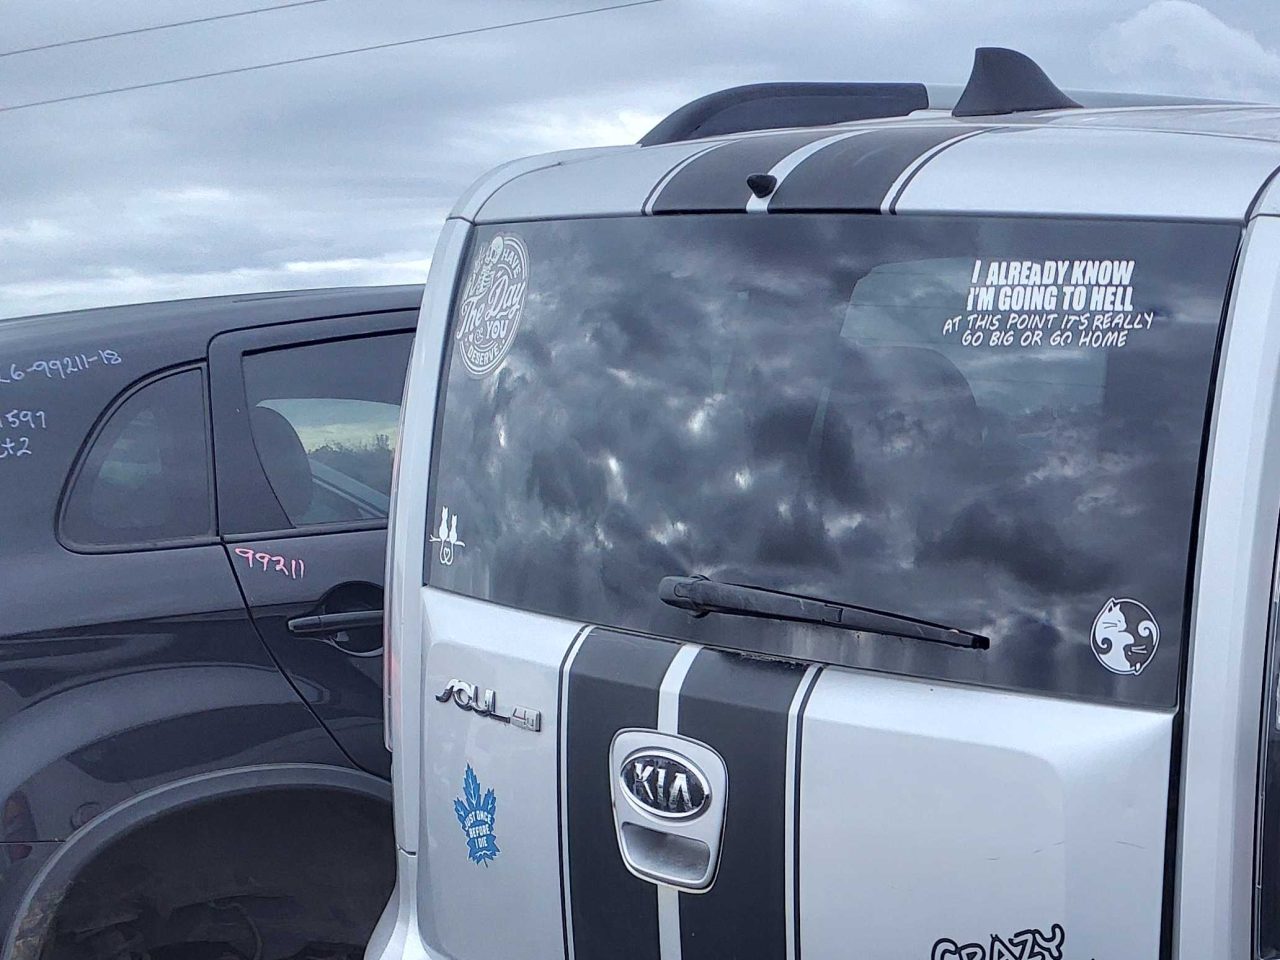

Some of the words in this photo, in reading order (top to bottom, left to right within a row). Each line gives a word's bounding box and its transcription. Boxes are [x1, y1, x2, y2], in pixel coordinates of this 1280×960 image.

[501, 249, 522, 279] HAVE
[971, 260, 981, 284] I
[986, 260, 1069, 285] ALREADY
[1071, 260, 1135, 285] KNOW
[457, 290, 487, 339] The
[485, 276, 526, 320] Day
[966, 286, 995, 311] I'M
[998, 286, 1057, 311] GOING
[1062, 286, 1088, 311] TO
[1090, 286, 1133, 311] HELL
[486, 319, 509, 340] YOU
[943, 315, 962, 336] AT
[967, 313, 1000, 330] THIS
[1006, 313, 1058, 330] POINT
[1061, 313, 1090, 330] IT'S
[1092, 312, 1154, 330] REALLY
[961, 330, 984, 347] GO
[989, 330, 1014, 347] BIG
[1020, 330, 1043, 347] OR
[1050, 330, 1073, 347] GO
[1079, 330, 1128, 347] HOME
[0, 349, 122, 383] 6-99211-18
[466, 345, 501, 366] DESERVE
[235, 547, 305, 579] 99211
[633, 762, 694, 811] KIA
[476, 810, 492, 825] ONCE
[469, 824, 490, 838] BEFORE
[478, 837, 488, 848] DIE
